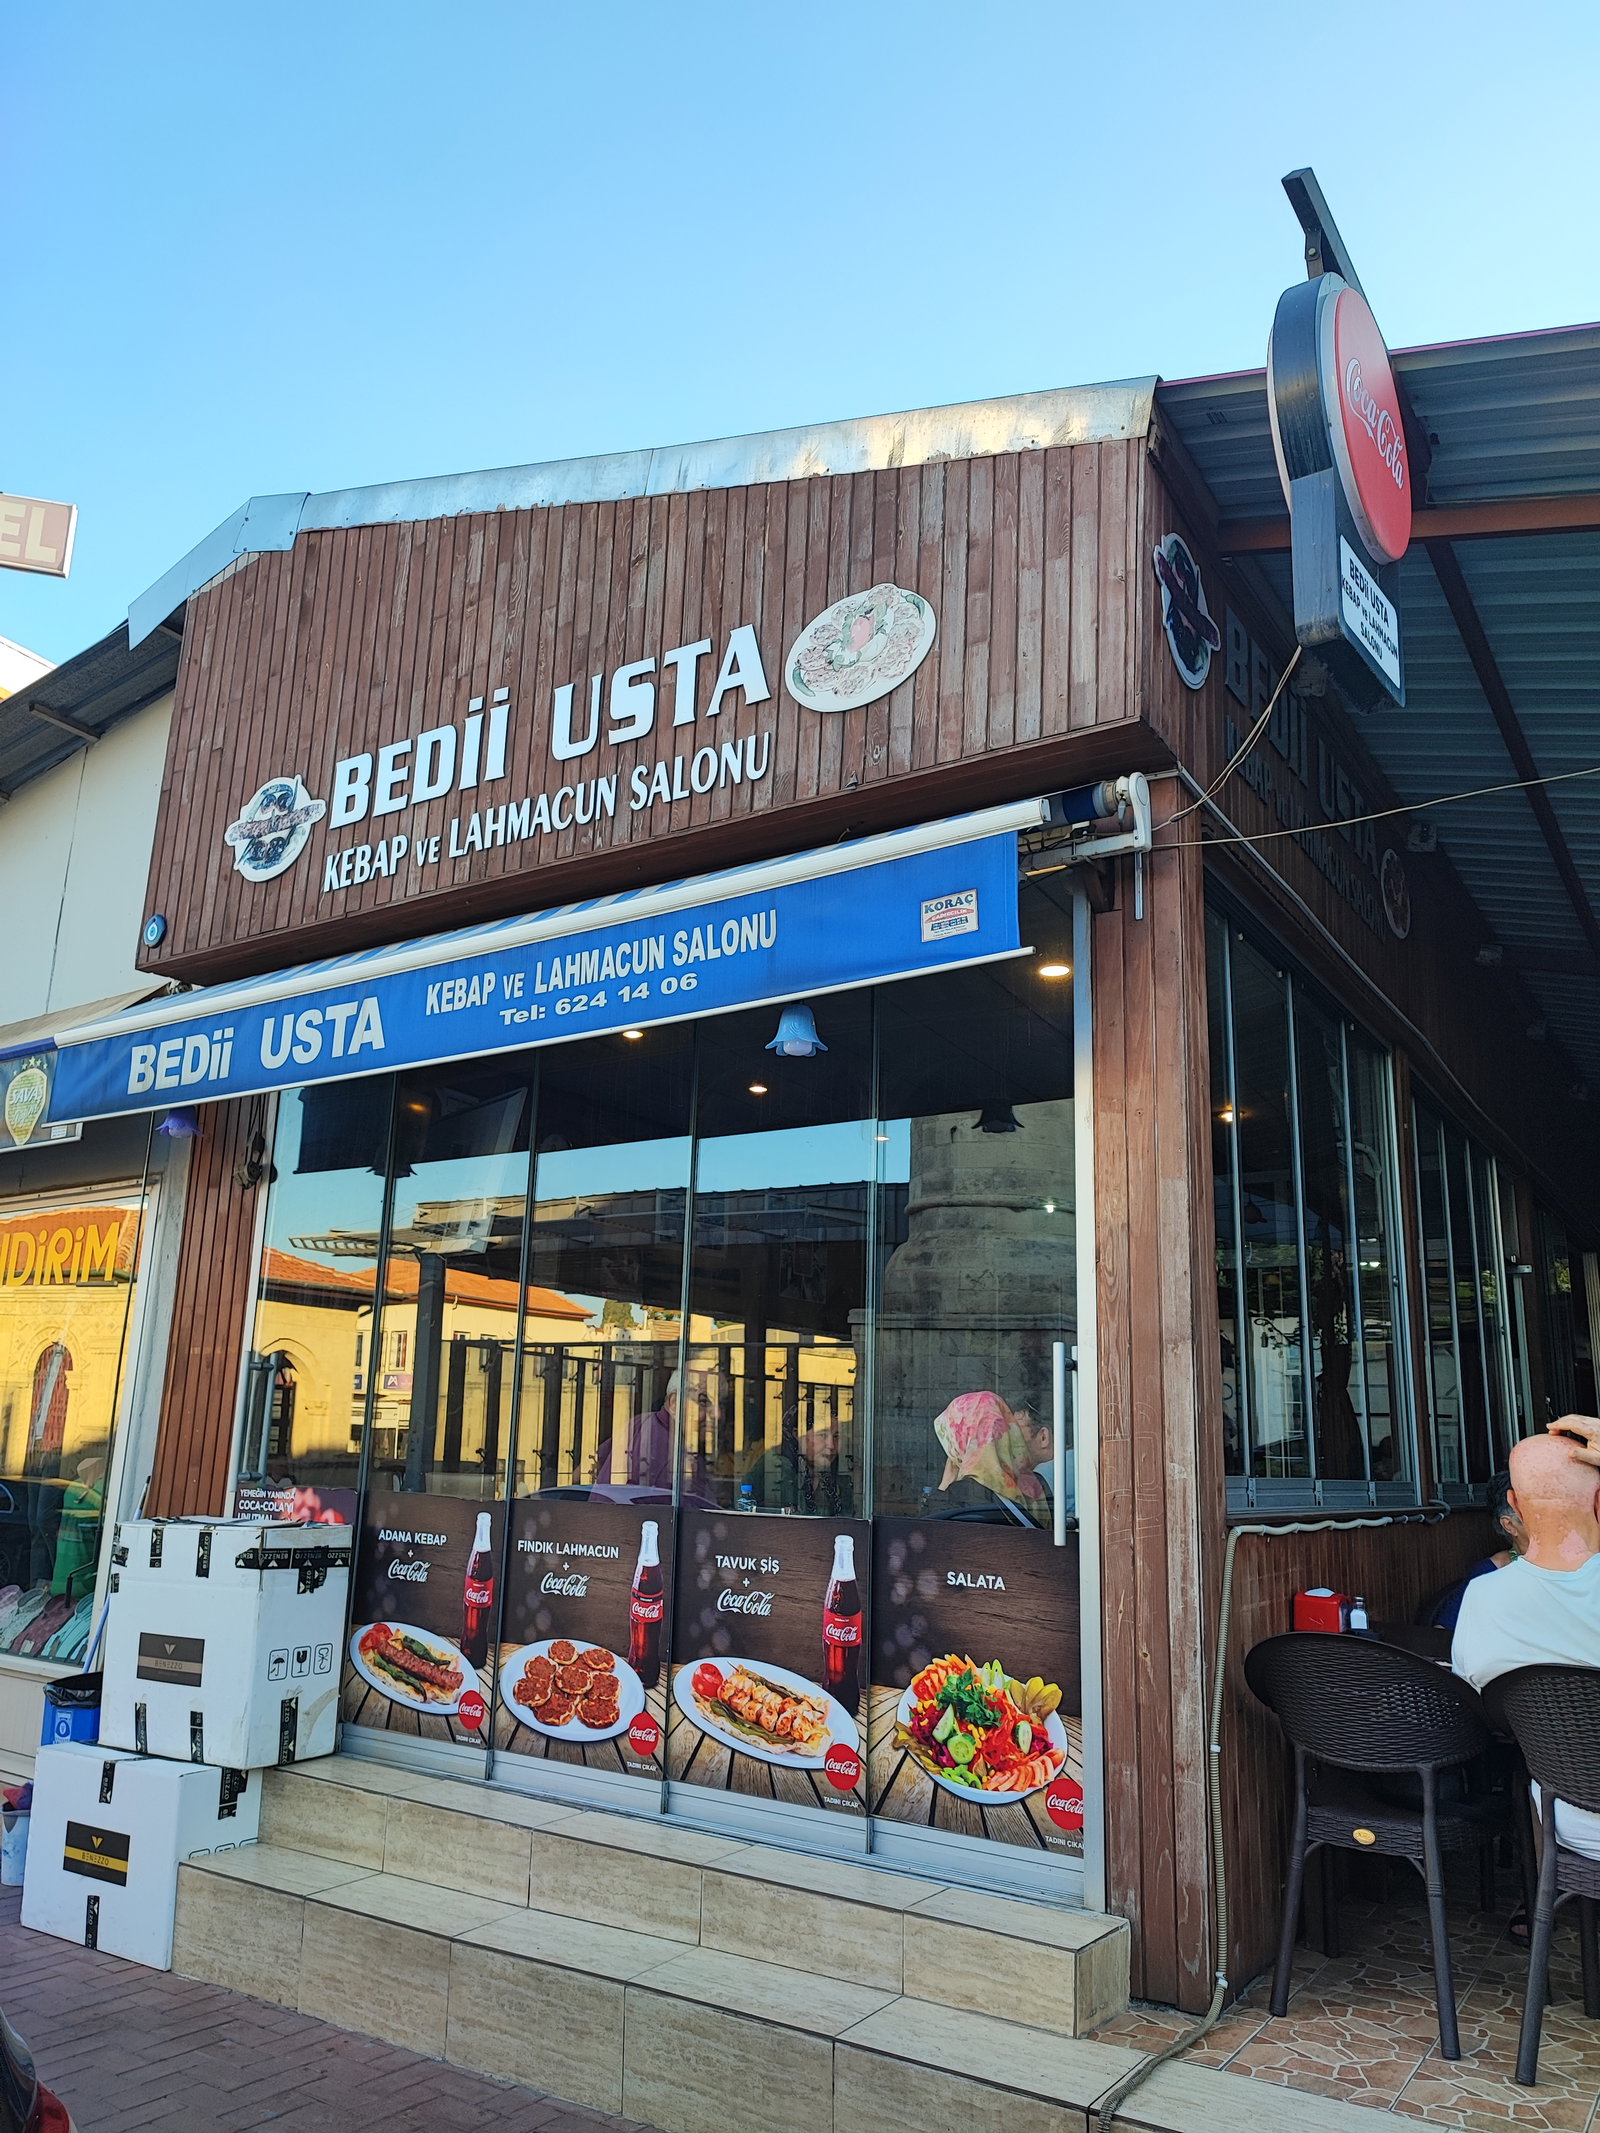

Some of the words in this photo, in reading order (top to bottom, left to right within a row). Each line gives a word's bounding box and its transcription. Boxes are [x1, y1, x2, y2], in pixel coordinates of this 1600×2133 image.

[1342, 574, 1361, 608] KEBAP
[1368, 611, 1398, 660] LAHMACUN
[1370, 586, 1390, 629] USTA
[1361, 622, 1383, 660] SALONU
[551, 623, 772, 761] USTA
[323, 834, 408, 893] KEBAP
[449, 774, 618, 858] LAHMACUN
[629, 731, 770, 811] SALONU
[425, 972, 496, 1016] KEBAP
[534, 934, 665, 995] LAHMACUN
[672, 909, 777, 967] SALONU
[499, 1005, 546, 1026] Tel:
[555, 994, 608, 1016] 624
[617, 983, 650, 1004] 14
[661, 973, 698, 996] 06
[260, 996, 386, 1070] USTA
[378, 1529, 412, 1543] ADANA
[414, 1532, 447, 1546] KEBAP
[517, 1540, 553, 1554] FINDIK
[556, 1543, 619, 1558] LAHMACUN
[388, 1558, 431, 1582] Coca-Cola
[715, 1555, 757, 1571] TAVUK
[760, 1556, 780, 1575] ŞİŞ
[946, 1571, 1006, 1591] SALATA
[540, 1572, 591, 1597] Coca-Cola
[717, 1588, 776, 1616] Coca-Cola
